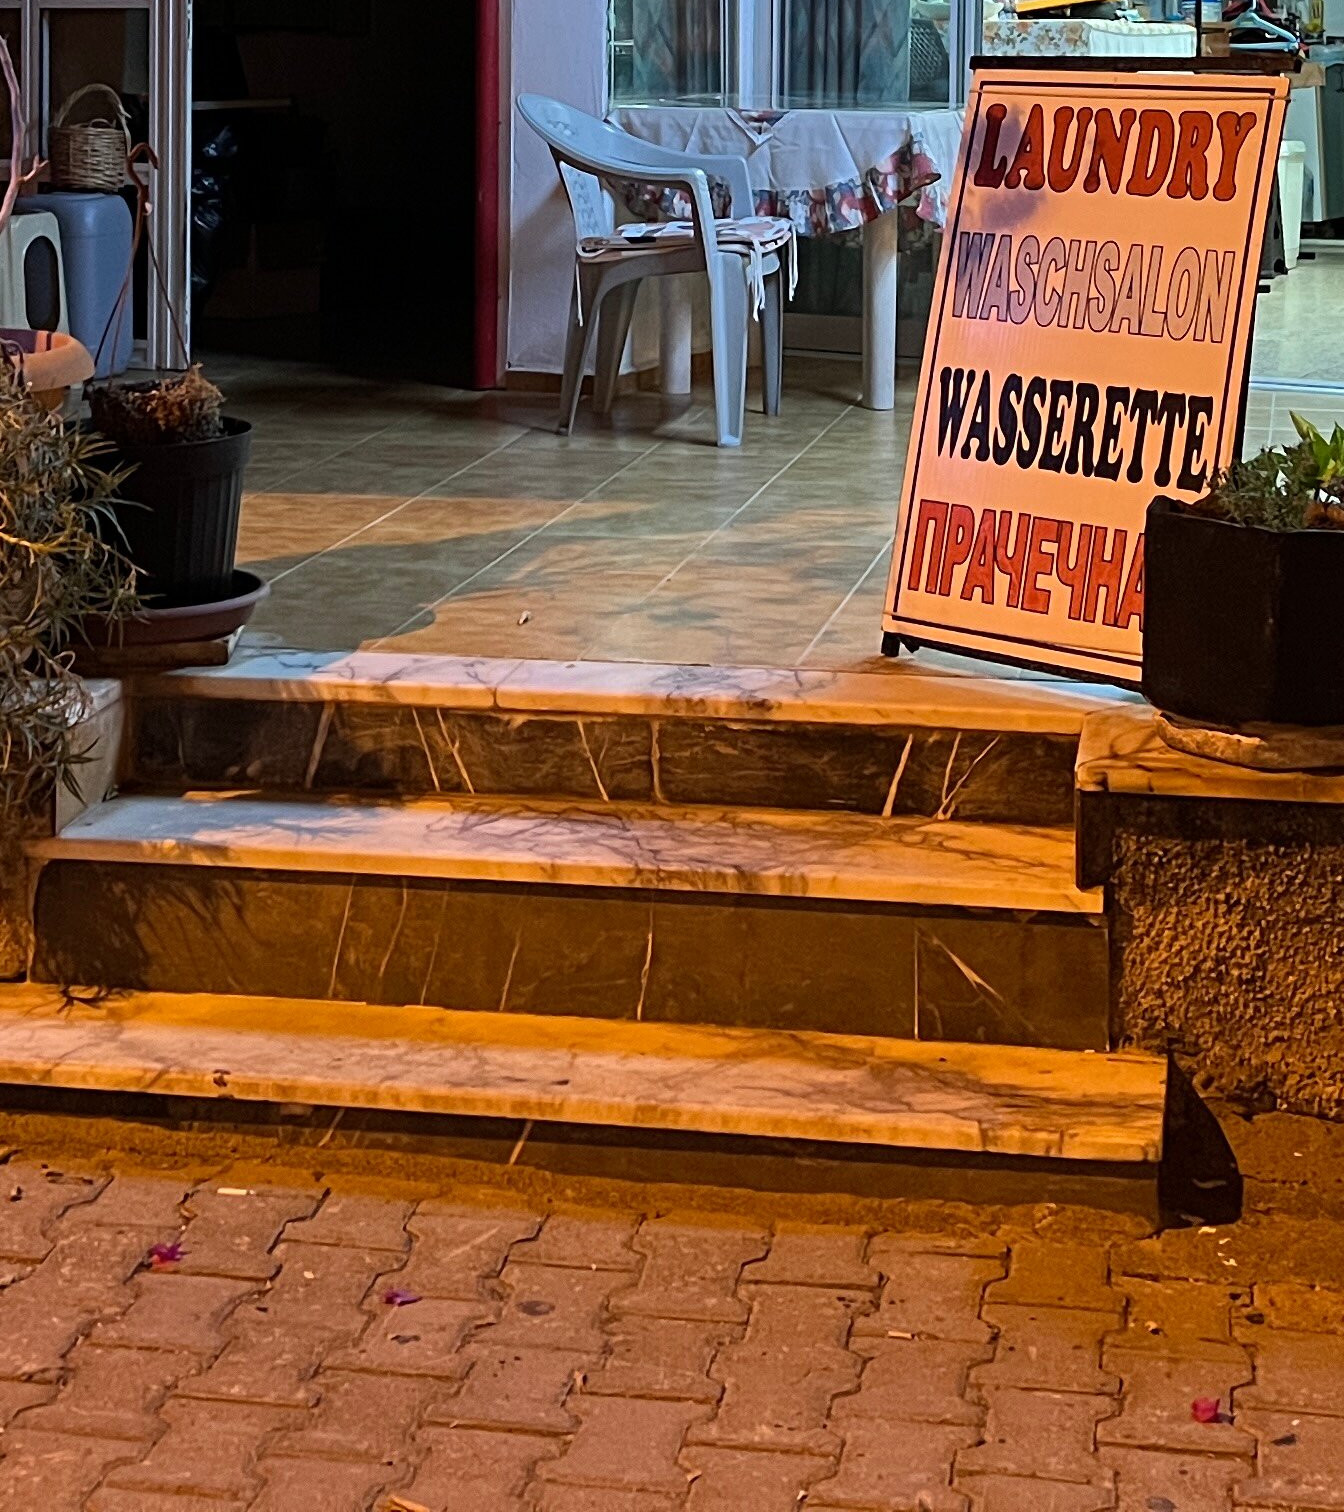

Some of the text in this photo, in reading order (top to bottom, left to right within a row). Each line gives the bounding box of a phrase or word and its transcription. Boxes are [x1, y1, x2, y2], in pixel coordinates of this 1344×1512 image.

[973, 103, 1256, 202] LAUNDRY
[952, 232, 1236, 344] WASCHSALON
[937, 366, 1215, 493] WASSERETTE
[907, 499, 1145, 634] ПРАЧЕЧНА
